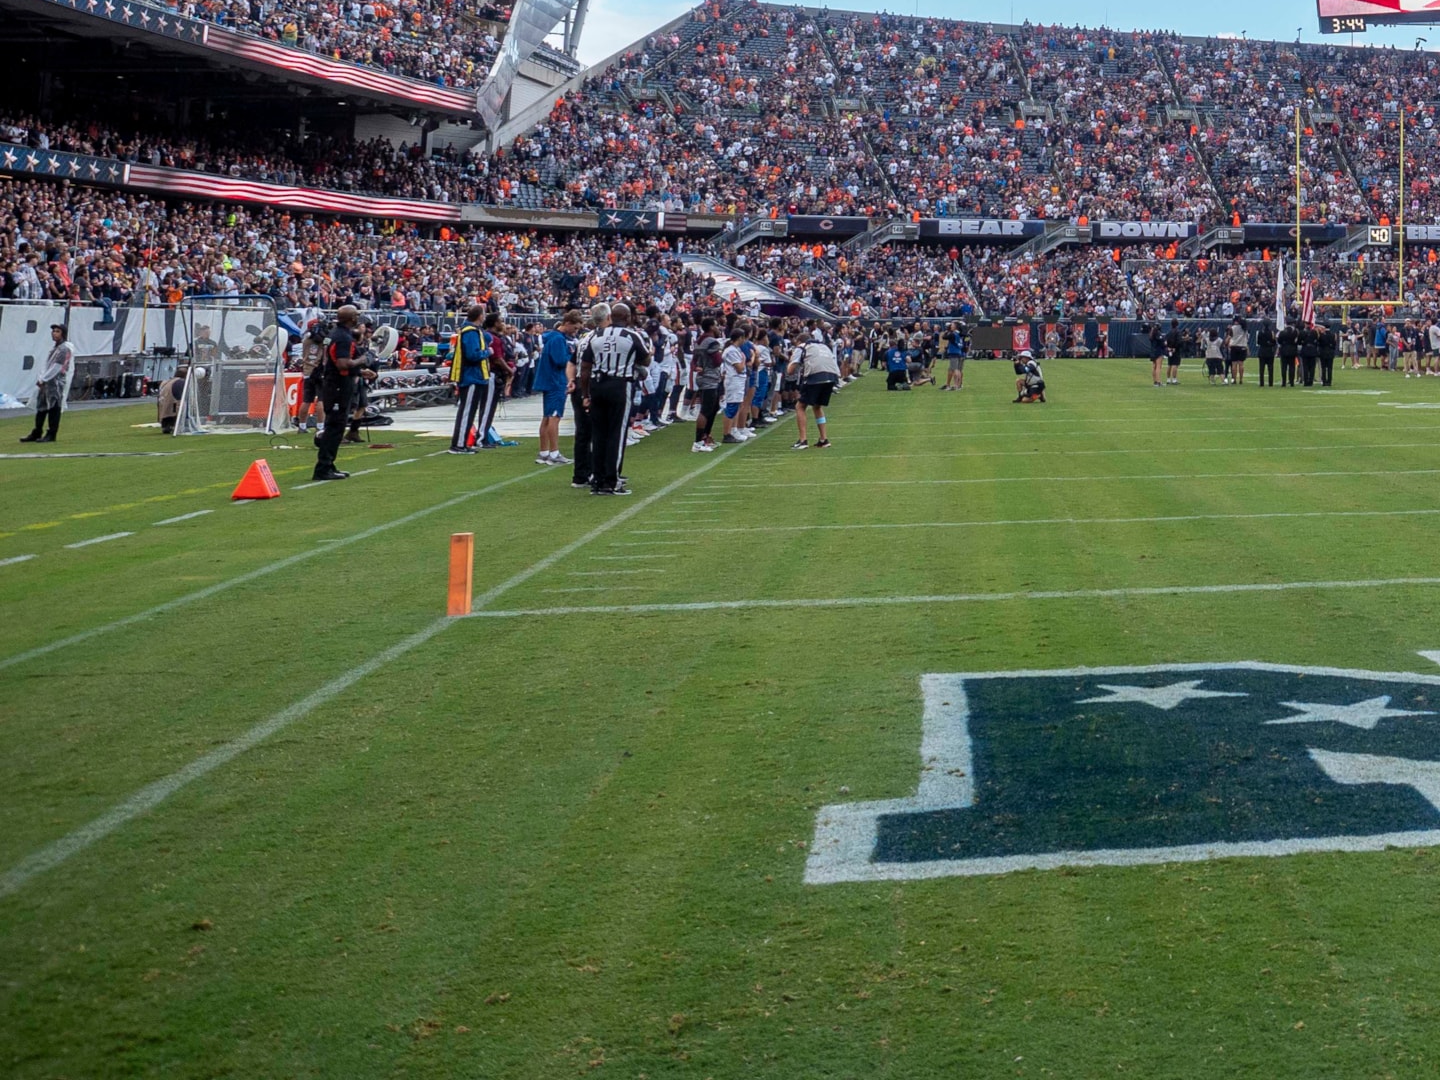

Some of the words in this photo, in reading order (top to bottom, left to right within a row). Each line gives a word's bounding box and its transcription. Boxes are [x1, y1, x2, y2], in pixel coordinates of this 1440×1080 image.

[1332, 18, 1364, 32] 3:44
[938, 220, 1024, 236] BEAR
[1100, 222, 1189, 238] DOWN
[1370, 229, 1388, 242] 40
[603, 342, 617, 352] 31
[287, 383, 298, 406] G
